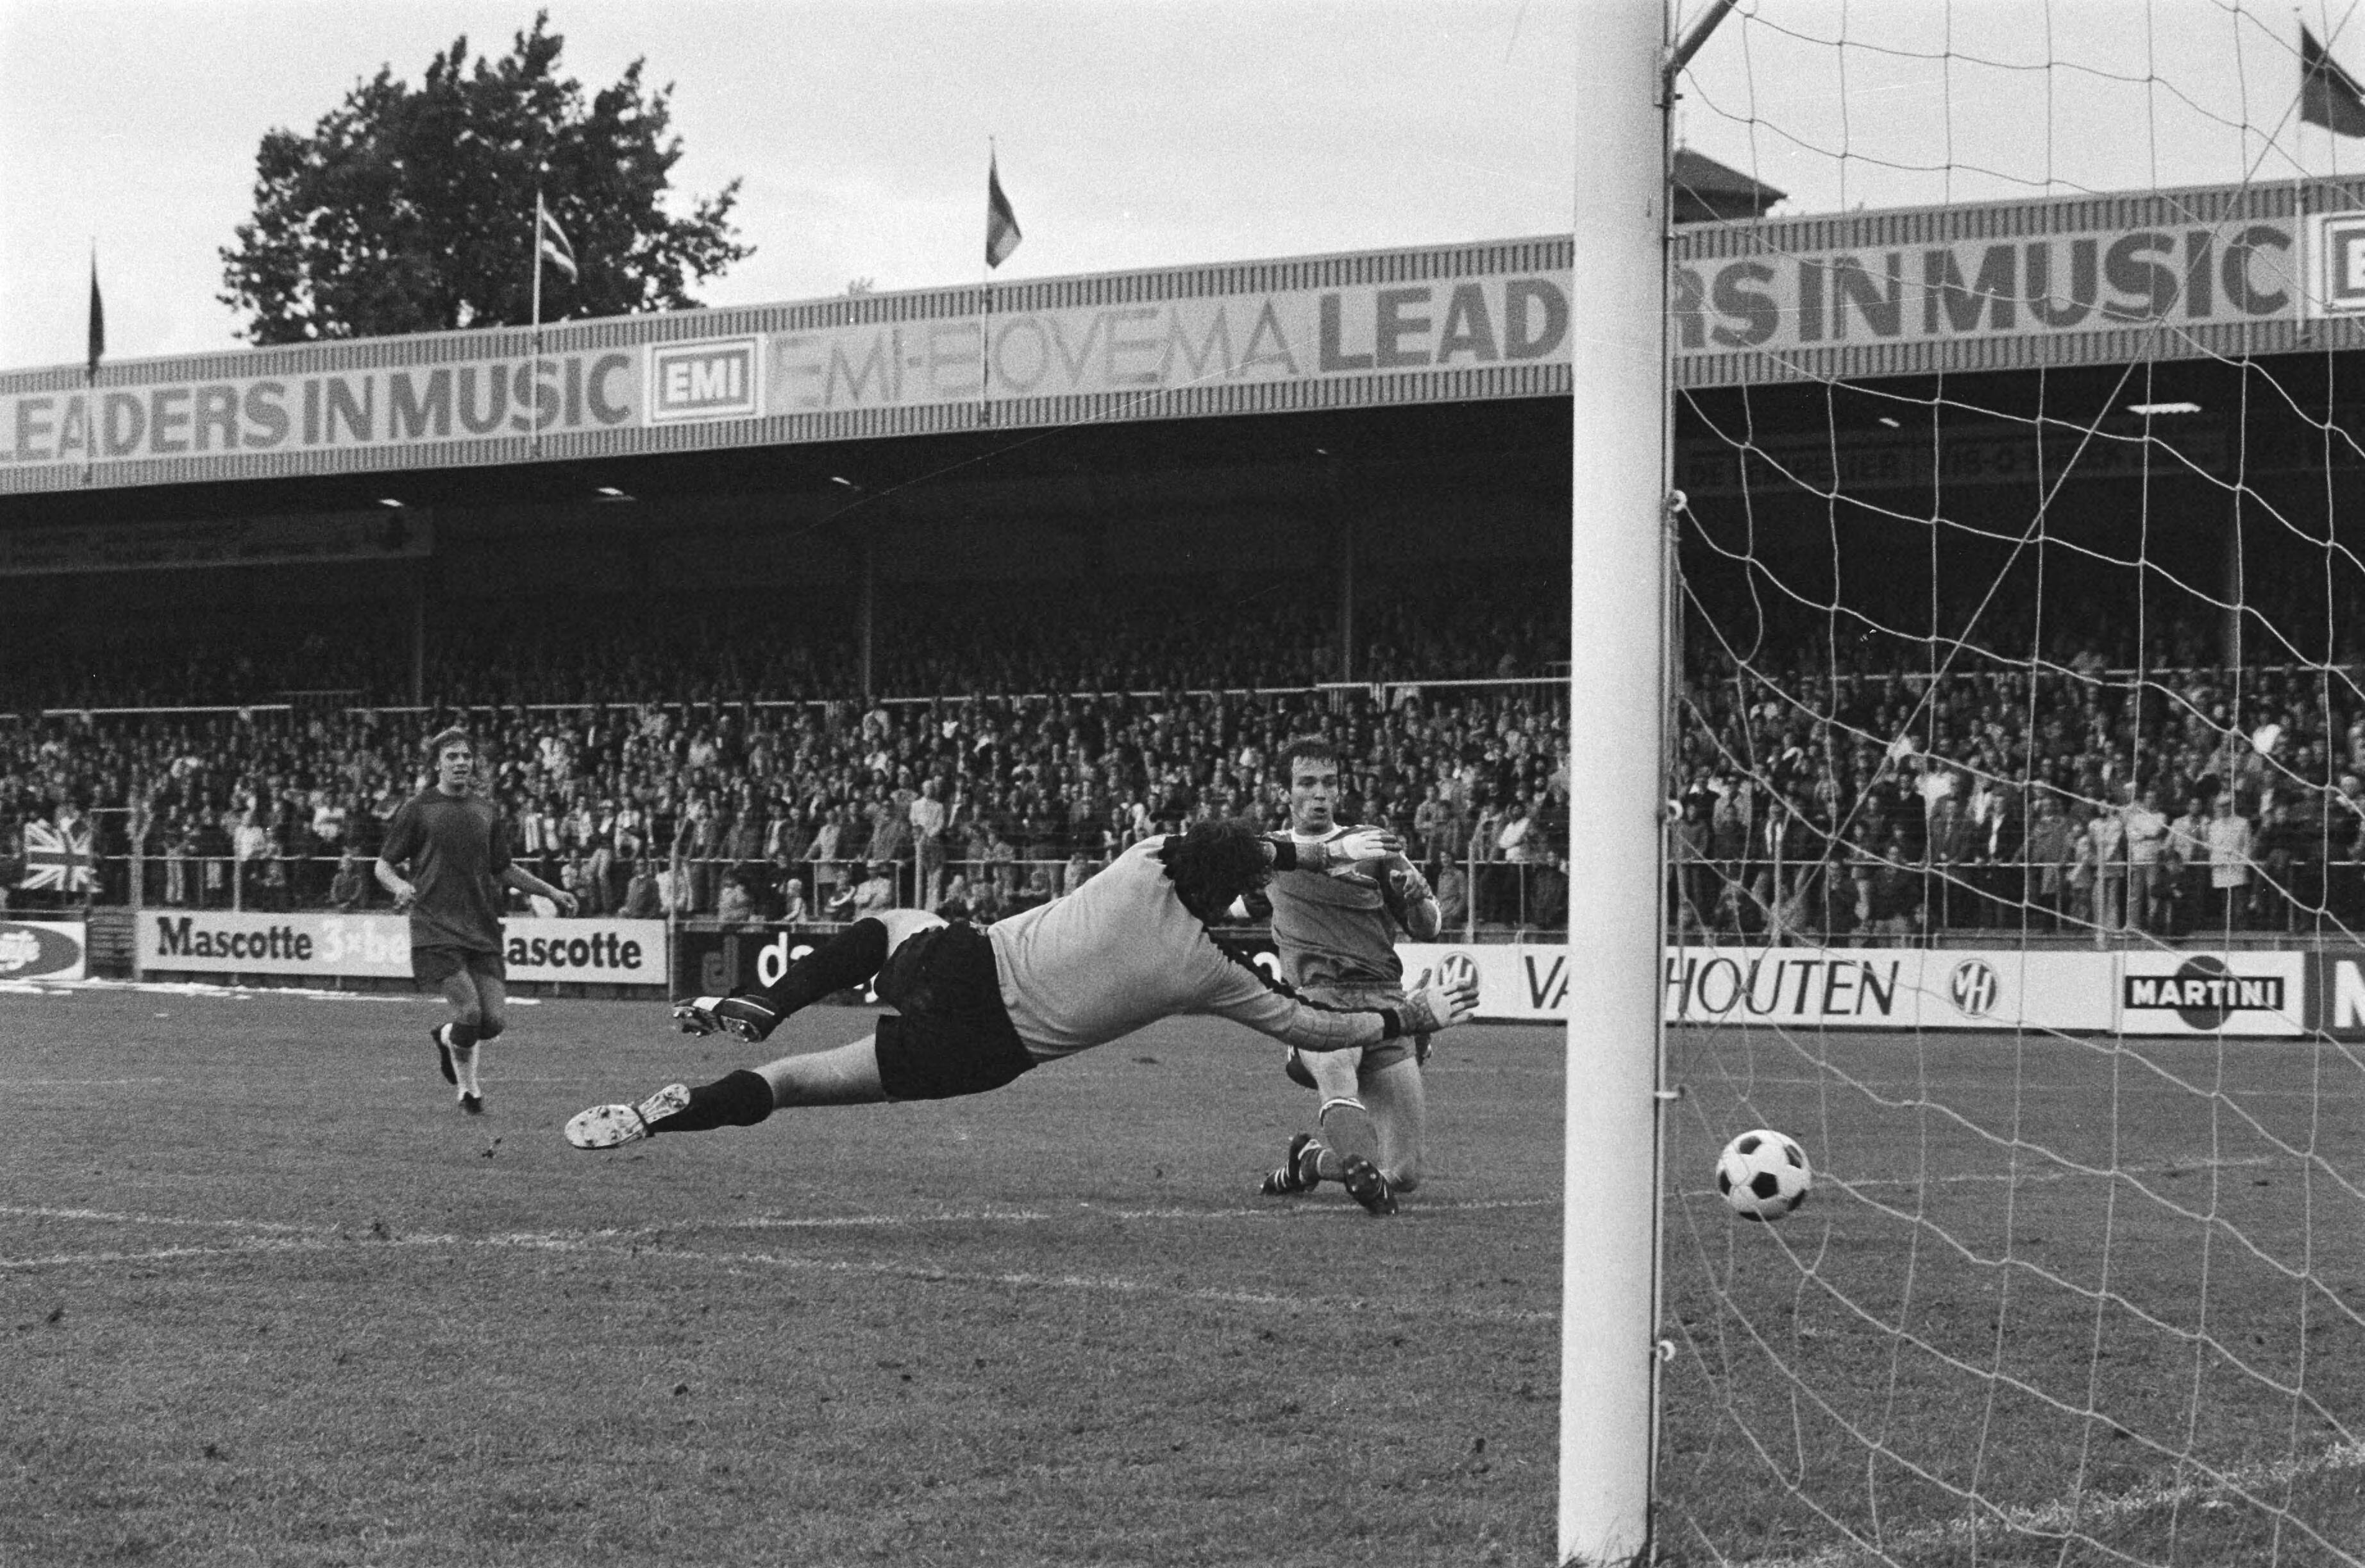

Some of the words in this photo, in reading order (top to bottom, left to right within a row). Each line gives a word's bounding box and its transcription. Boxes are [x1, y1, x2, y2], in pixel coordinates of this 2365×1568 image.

[1319, 260, 1781, 373] LEADRS
[1924, 224, 2292, 334] MUSIC
[665, 356, 743, 403] EMI
[0, 382, 290, 462] EADERS
[389, 353, 632, 441] MUSIC
[156, 916, 313, 961] Mascotte
[506, 932, 642, 970] ascotte
[1666, 957, 1899, 1016] HOUTEN
[2132, 979, 2277, 1007] MARTINI
